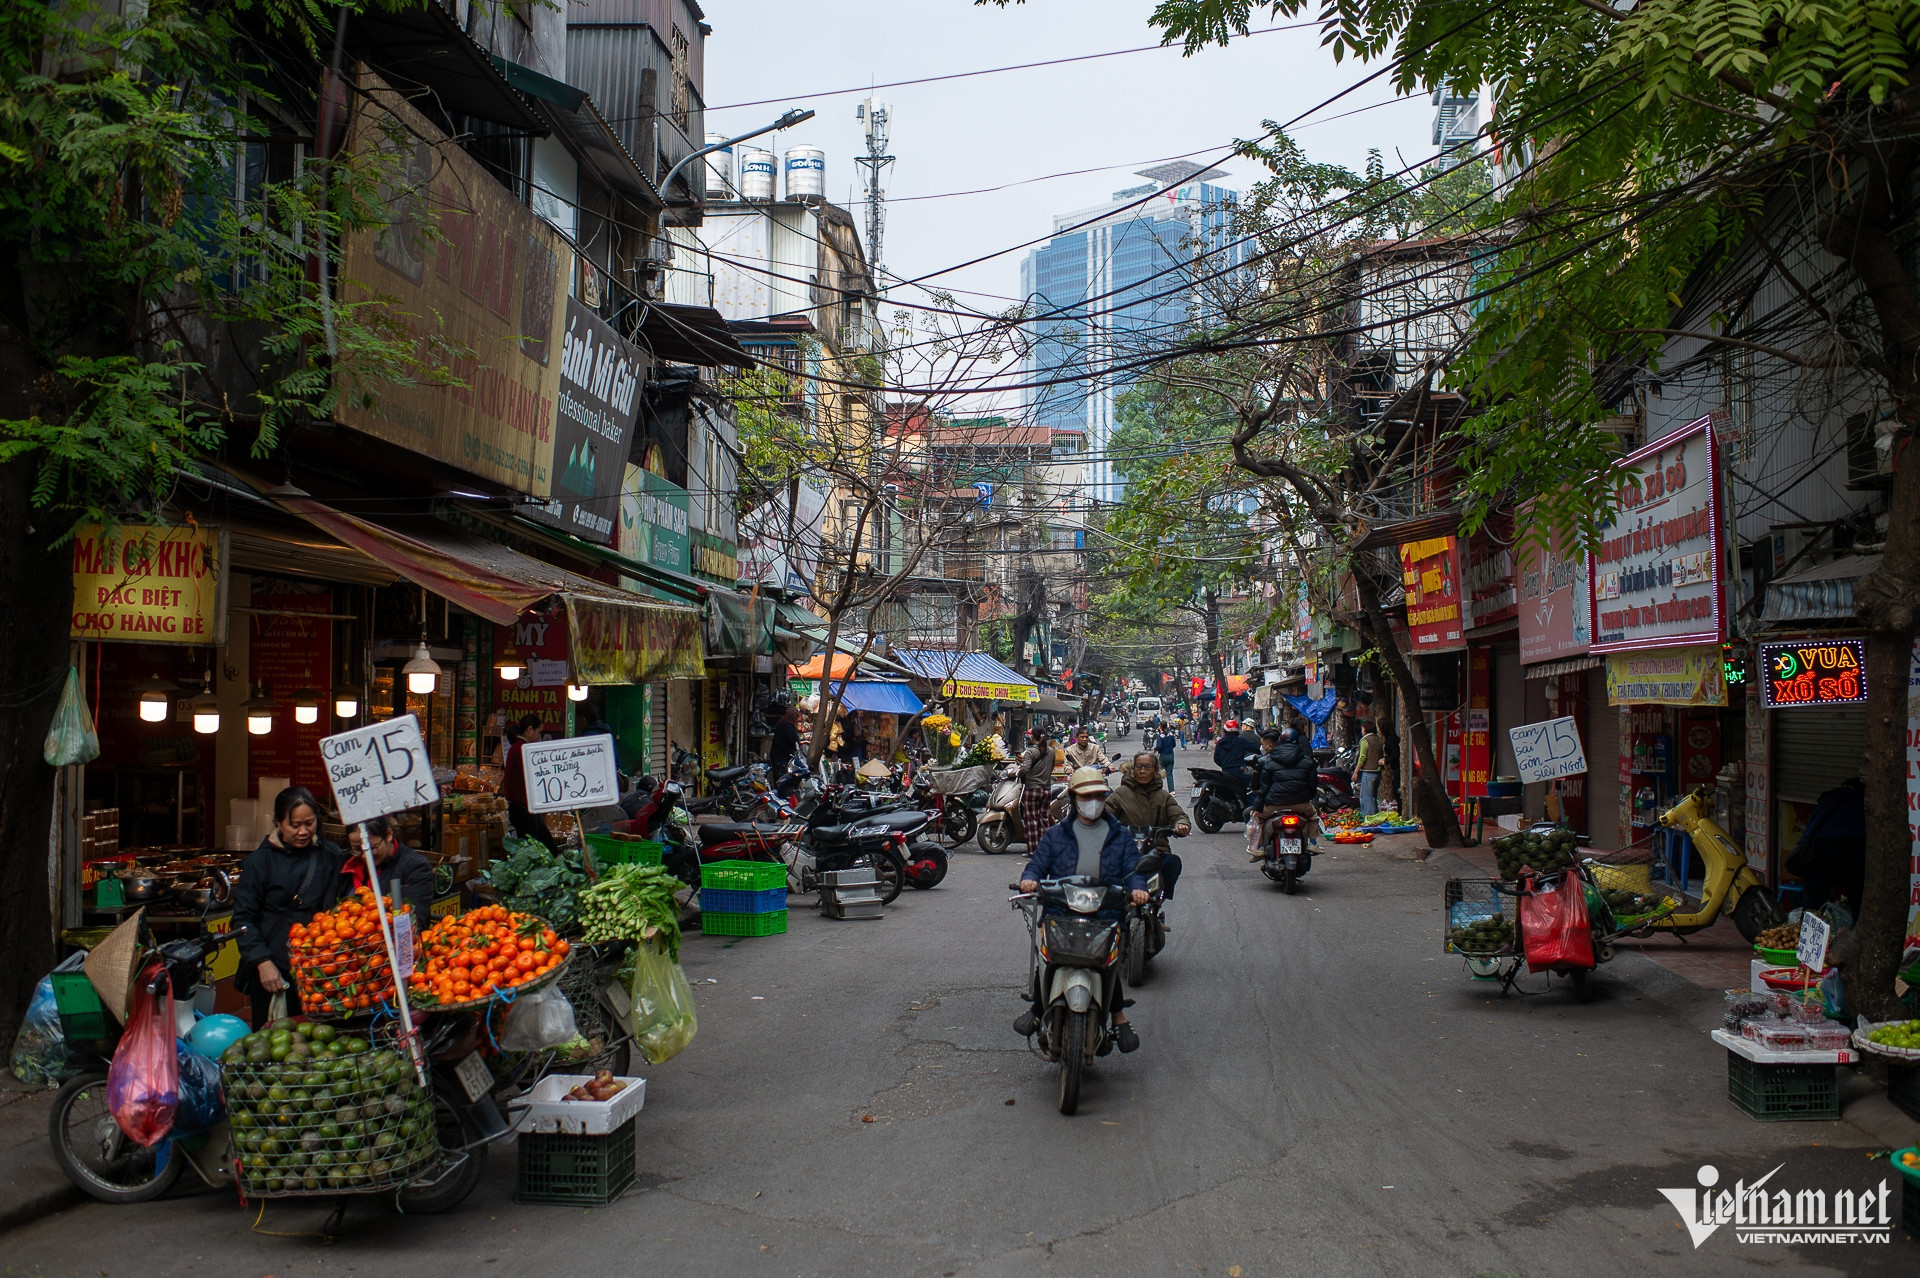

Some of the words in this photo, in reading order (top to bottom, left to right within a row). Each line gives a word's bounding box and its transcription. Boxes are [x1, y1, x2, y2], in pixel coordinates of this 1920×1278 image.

[600, 411, 623, 445] baker
[1644, 455, 1664, 503] XỔ
[1665, 443, 1686, 493] SỐ
[141, 585, 182, 610] BIỆT
[72, 612, 115, 635] CHỢ
[120, 610, 176, 634] HÀNG
[182, 612, 204, 635] BÈ
[1601, 609, 1623, 631] TRUNG
[1641, 597, 1657, 625] TRẢ
[1656, 592, 1691, 624] THƯỞNG
[1690, 595, 1711, 619] CAO
[514, 615, 550, 647] MỲ
[1662, 657, 1685, 674] NHANH
[1797, 646, 1858, 670] VUA
[1627, 680, 1648, 698] THƯỞNG
[1661, 682, 1680, 697] TRONG
[1725, 671, 1742, 682] HẬT
[1773, 670, 1817, 702] XỔ
[1818, 667, 1861, 699] SỐ
[502, 686, 540, 704] BÁNH
[542, 691, 558, 704] TA
[505, 706, 532, 723] ÁNH
[538, 707, 564, 724] TÂY
[1631, 704, 1663, 734] PHẨM
[323, 737, 362, 760] Cam
[1534, 718, 1577, 763] 15
[365, 729, 414, 785] 15
[330, 763, 362, 783] Siêu
[337, 777, 370, 805] ngọt
[537, 776, 563, 804] 10
[569, 772, 588, 799] 2
[1560, 779, 1584, 798] CHAY
